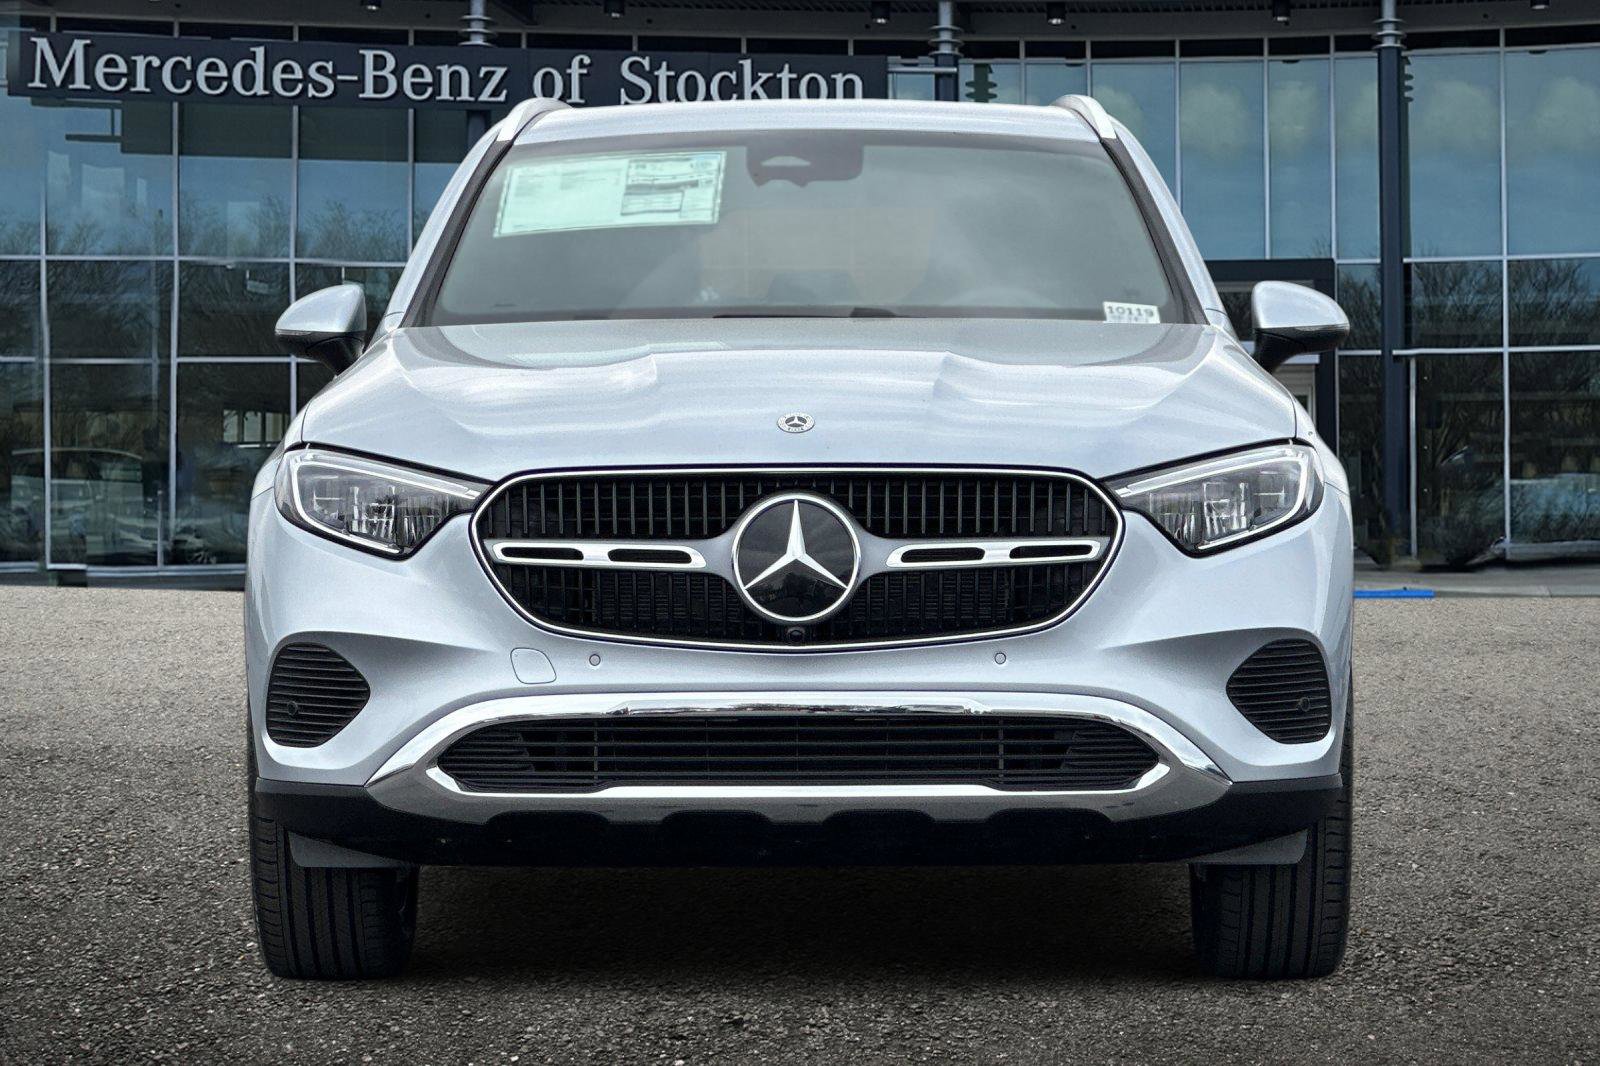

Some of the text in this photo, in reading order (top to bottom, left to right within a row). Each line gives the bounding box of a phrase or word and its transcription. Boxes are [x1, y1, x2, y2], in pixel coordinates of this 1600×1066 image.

[28, 37, 865, 104] Mercedes-Benz of Stockton
